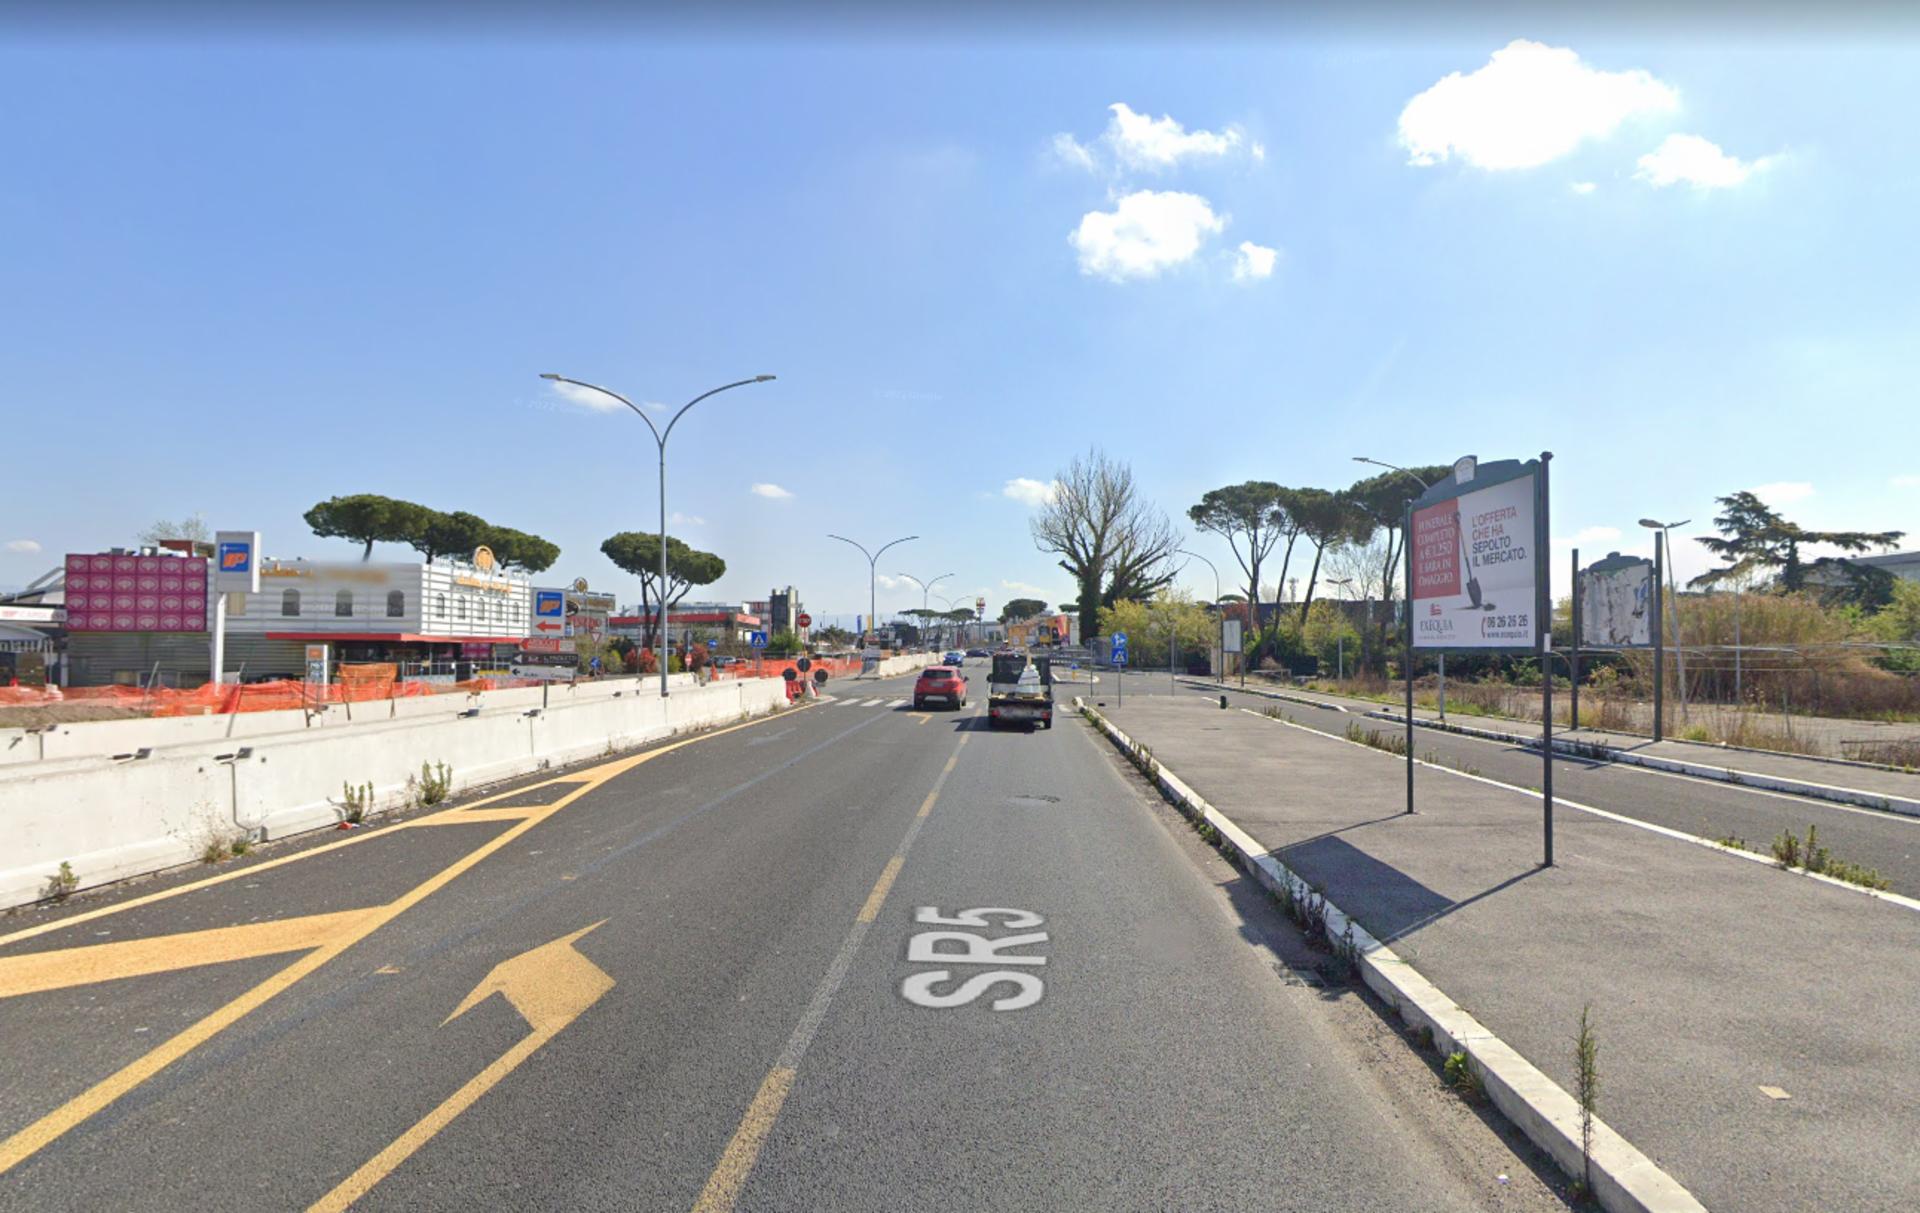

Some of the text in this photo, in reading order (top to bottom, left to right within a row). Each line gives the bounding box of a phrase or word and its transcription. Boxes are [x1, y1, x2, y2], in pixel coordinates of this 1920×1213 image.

[1472, 506, 1517, 528] L'OFFERTA
[1472, 523, 1504, 541] CHE HA
[1472, 536, 1511, 554] SEPOLTO
[1472, 546, 1527, 567] IL MERCATO.
[1518, 614, 1528, 627] 26
[902, 906, 1049, 1011] SR5
